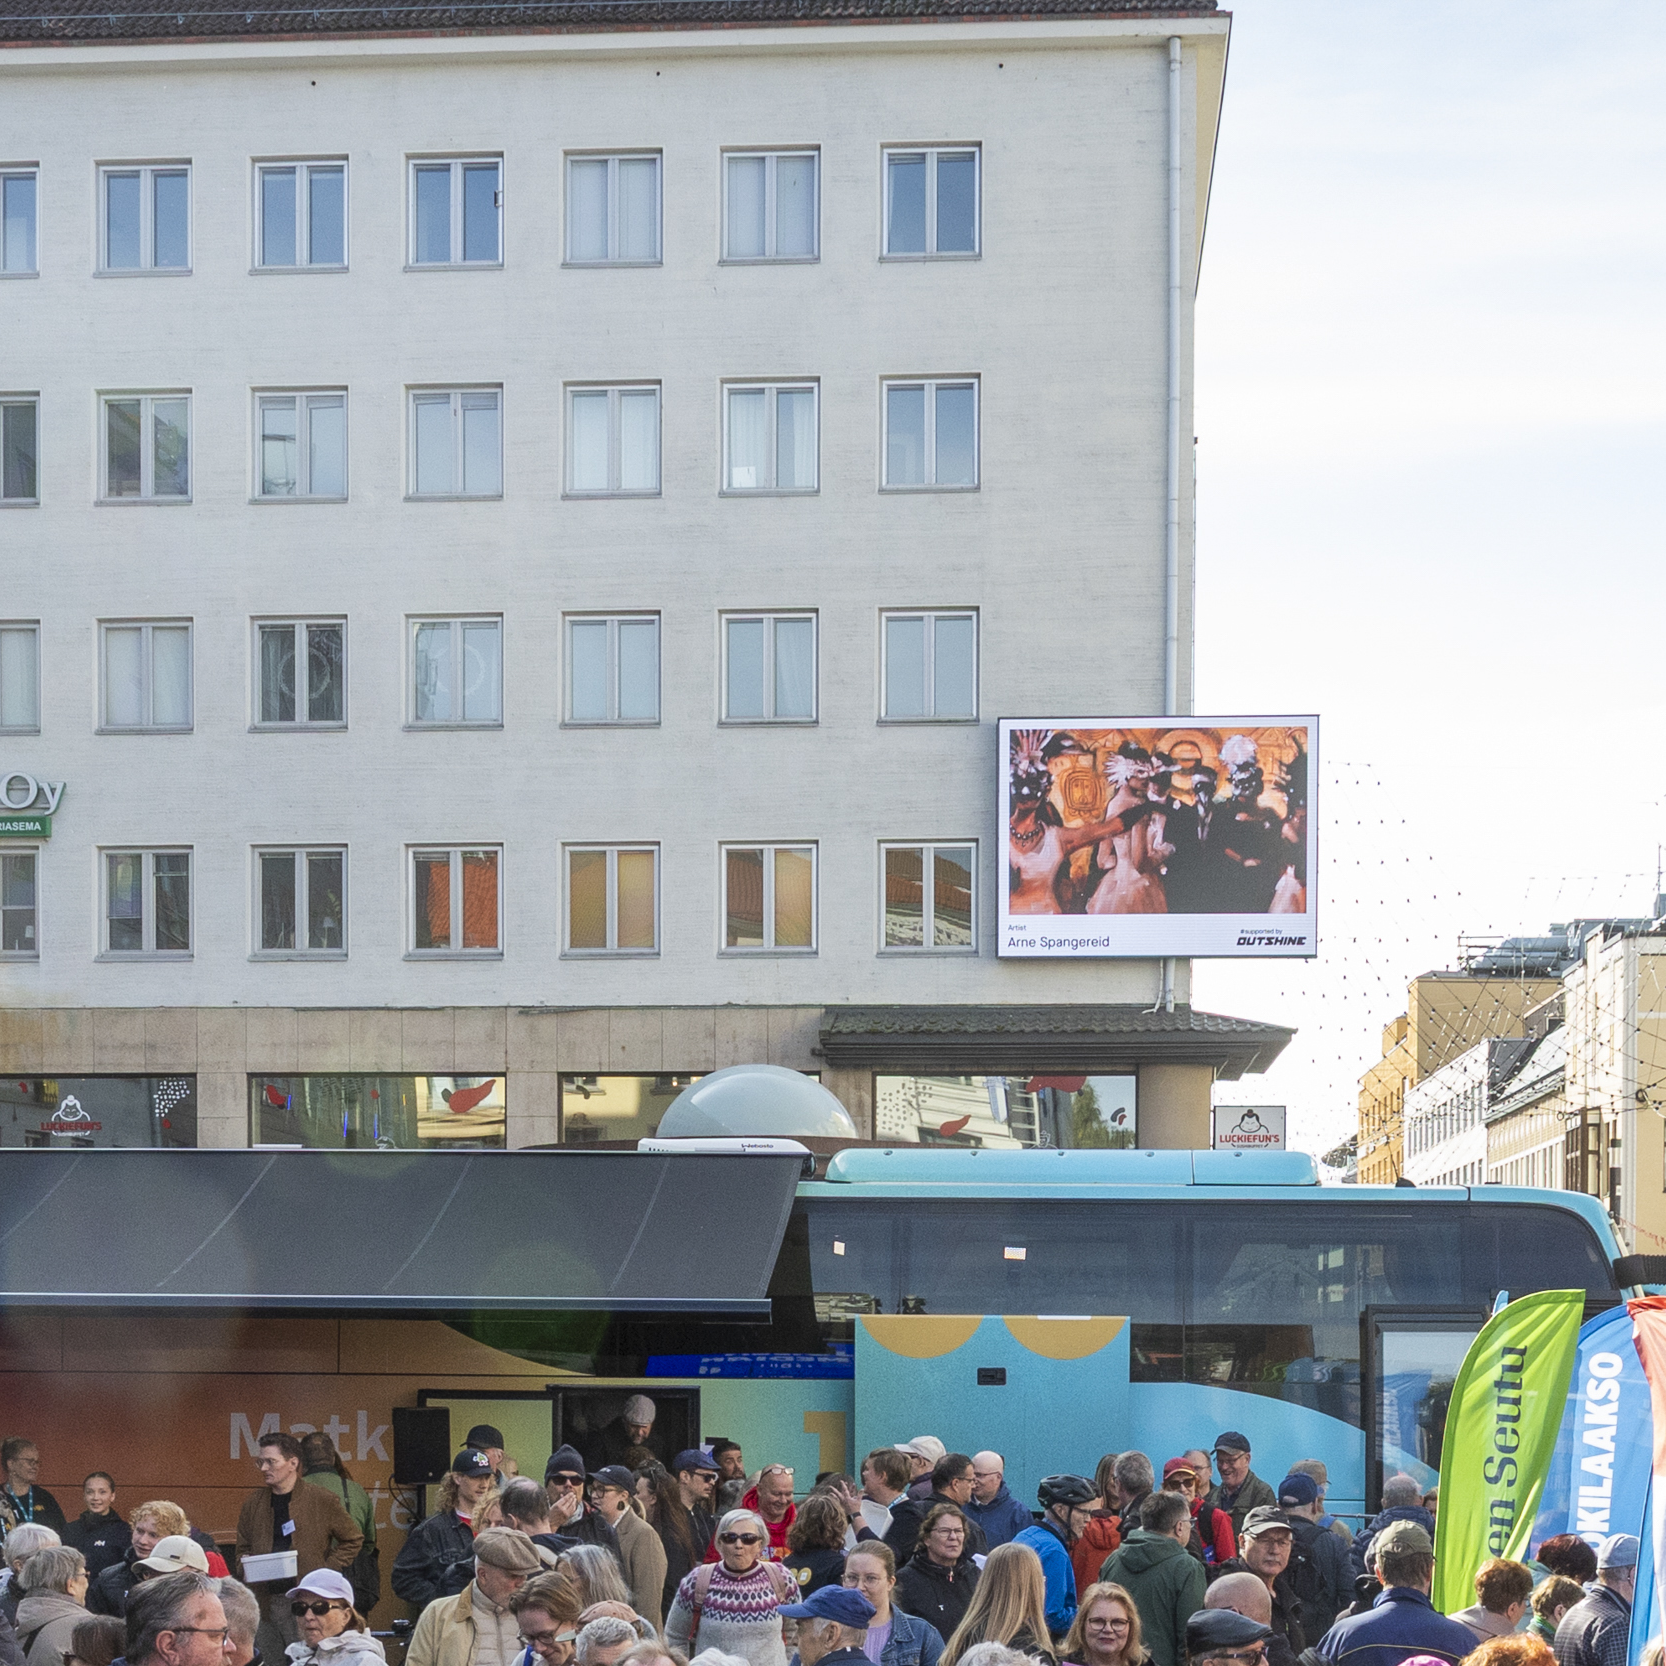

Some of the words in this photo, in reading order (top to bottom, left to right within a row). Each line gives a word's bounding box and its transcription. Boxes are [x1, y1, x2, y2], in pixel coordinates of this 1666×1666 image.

[1008, 936, 1036, 947] Arne
[1040, 936, 1110, 950] Spangereid
[1236, 936, 1307, 946] OUTSHINE
[1219, 1134, 1280, 1143] LUCKIEFUN'S
[1483, 1345, 1528, 1488] Seutu
